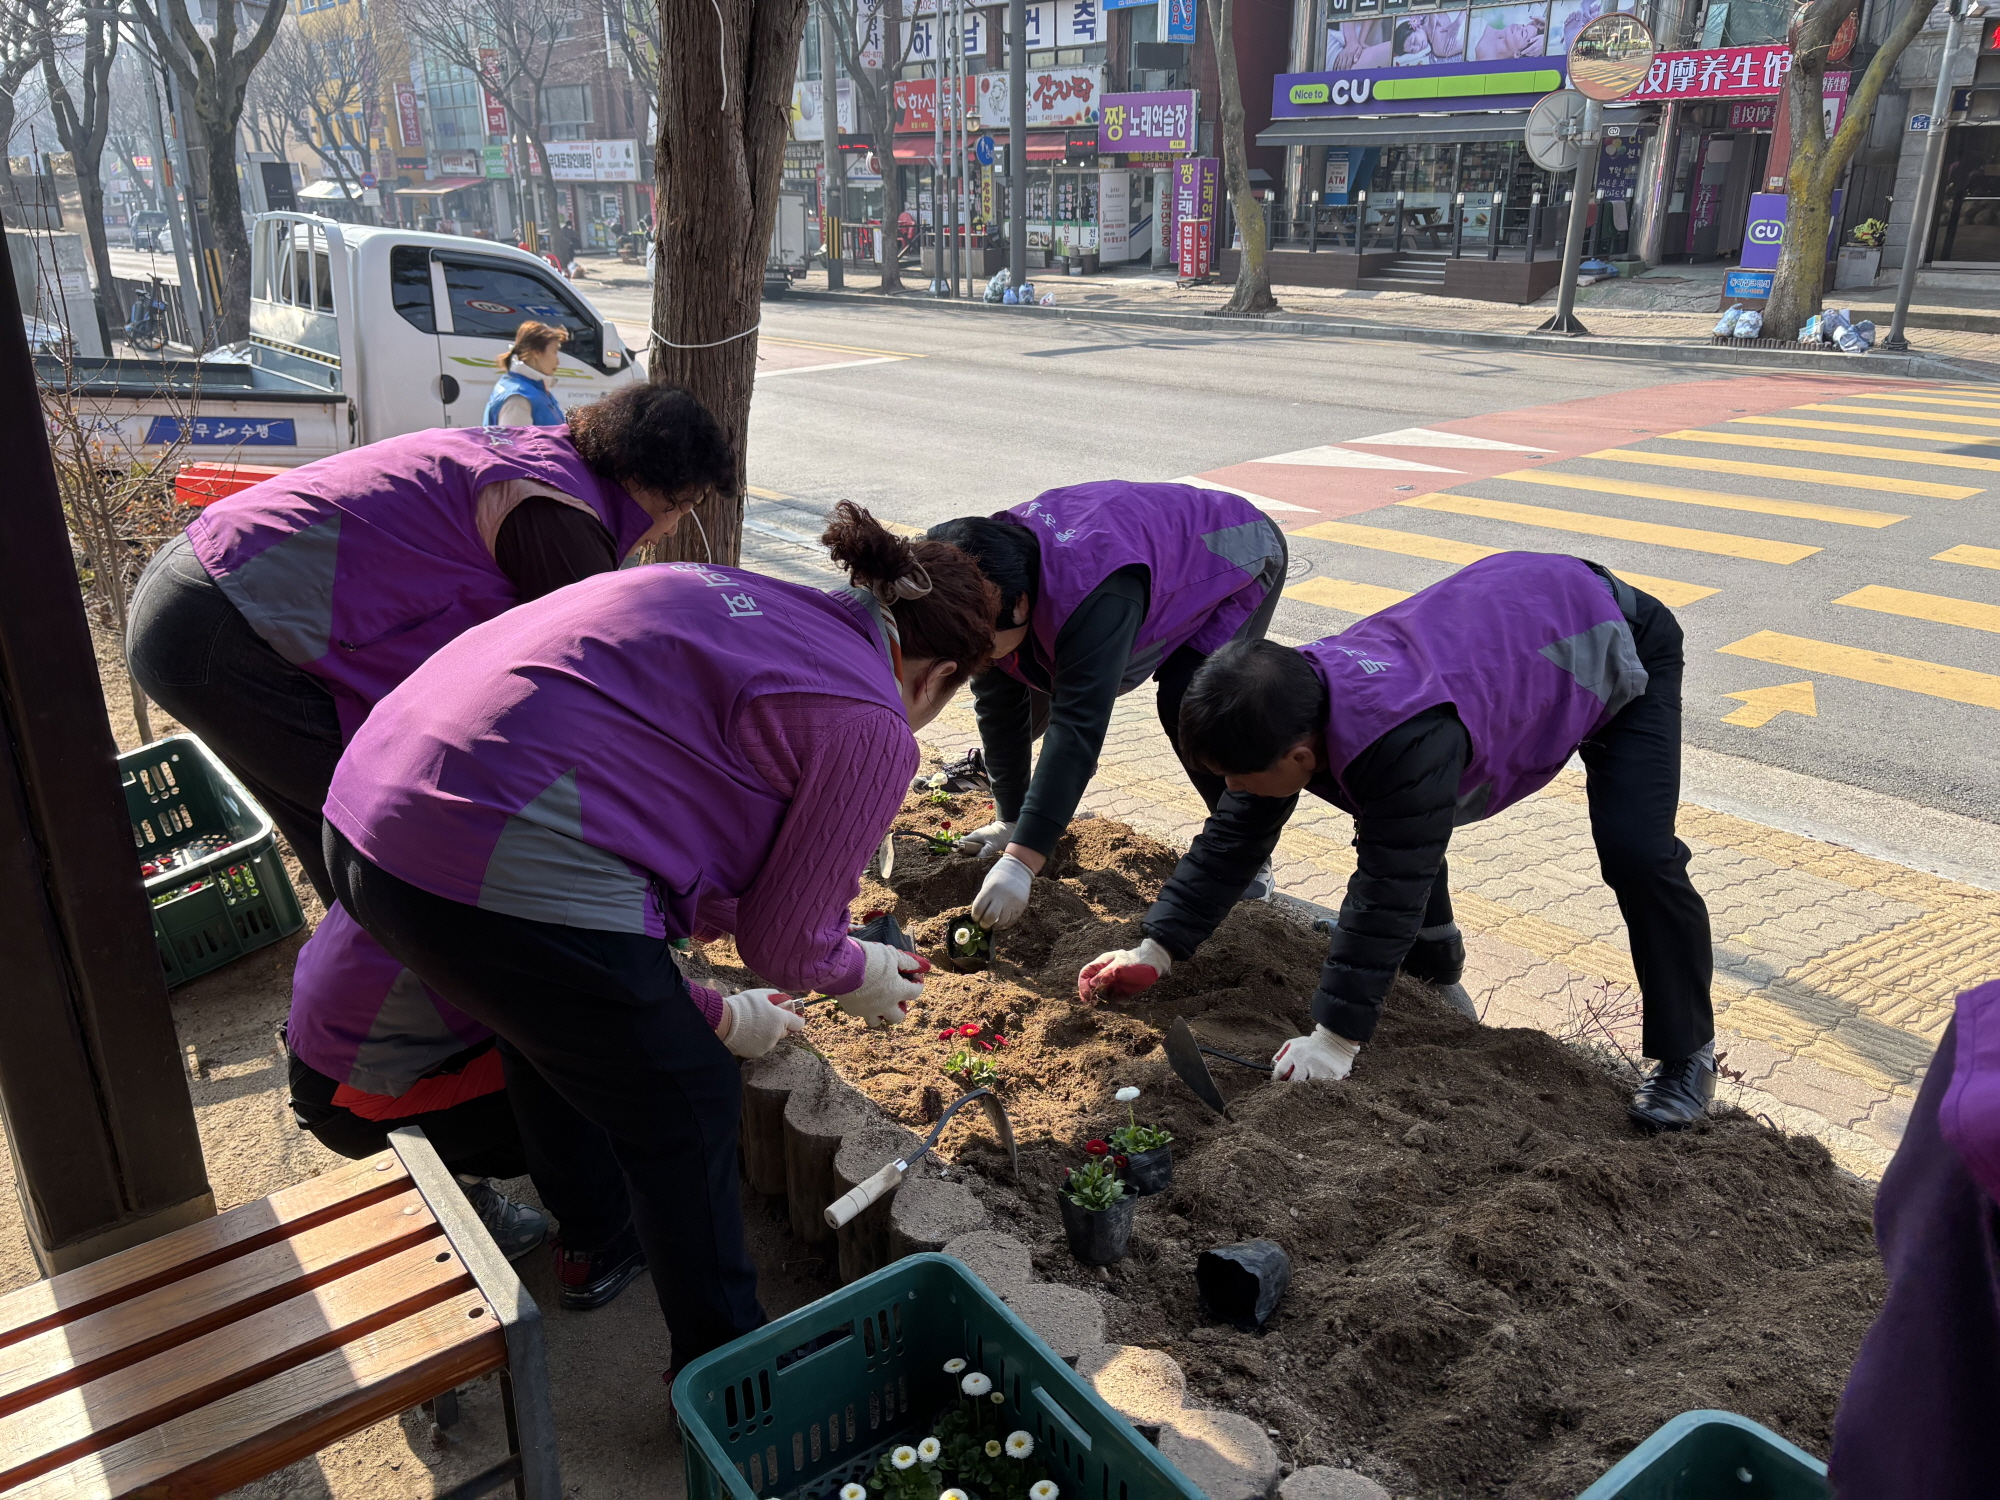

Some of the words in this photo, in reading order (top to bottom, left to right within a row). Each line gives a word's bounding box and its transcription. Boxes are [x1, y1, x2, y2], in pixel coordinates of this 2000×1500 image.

[1033, 74, 1094, 111] 감자탕
[1295, 90, 1313, 100] Nice
[1315, 90, 1323, 99] to
[1332, 79, 1371, 105] CU
[1104, 105, 1126, 141] 짱
[1129, 105, 1188, 138] 노래연습장
[1180, 164, 1195, 184] 짱
[1328, 176, 1346, 185] ATM
[1755, 225, 1779, 238] CU
[240, 423, 269, 438] 수행
